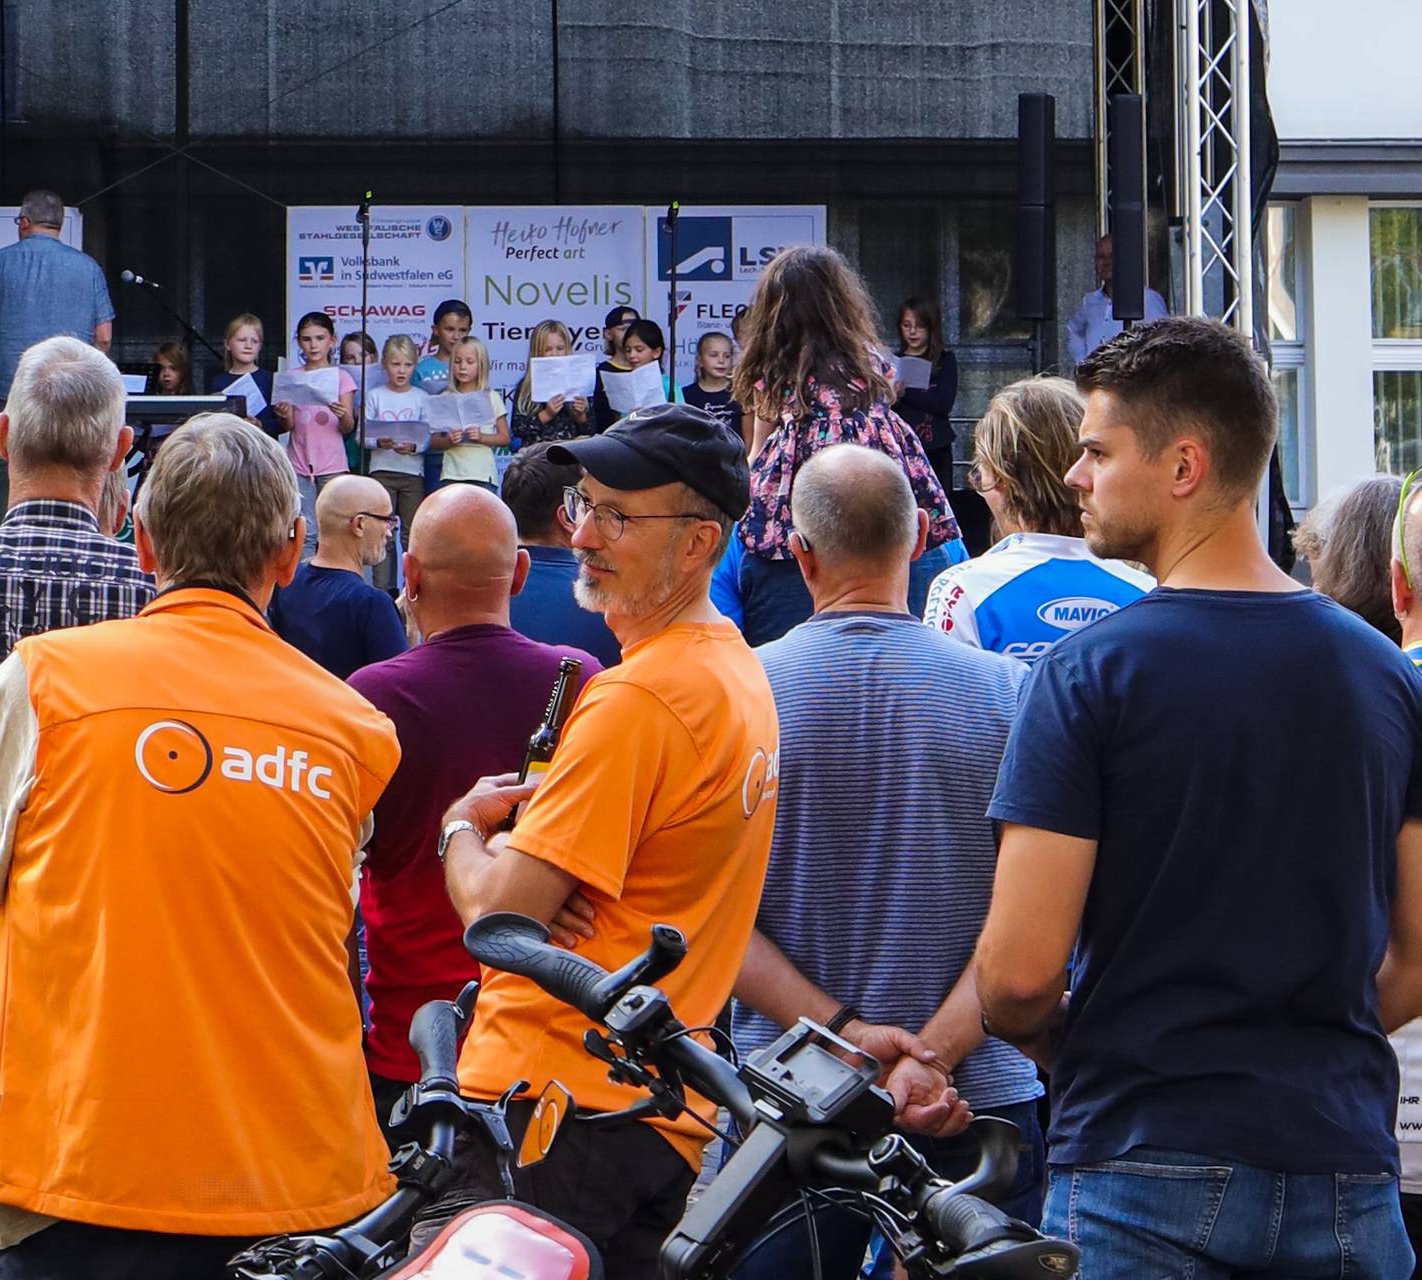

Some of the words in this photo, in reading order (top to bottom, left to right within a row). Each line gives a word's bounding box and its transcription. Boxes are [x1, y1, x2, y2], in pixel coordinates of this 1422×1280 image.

[298, 232, 422, 240] STAHLGESELSCHAFT
[505, 247, 559, 262] Perfect
[563, 248, 586, 260] art
[340, 270, 352, 281] in
[437, 270, 454, 281] eG
[484, 274, 632, 306] Novelis
[323, 305, 426, 317] SCHAWAG
[220, 745, 332, 800] adfc
